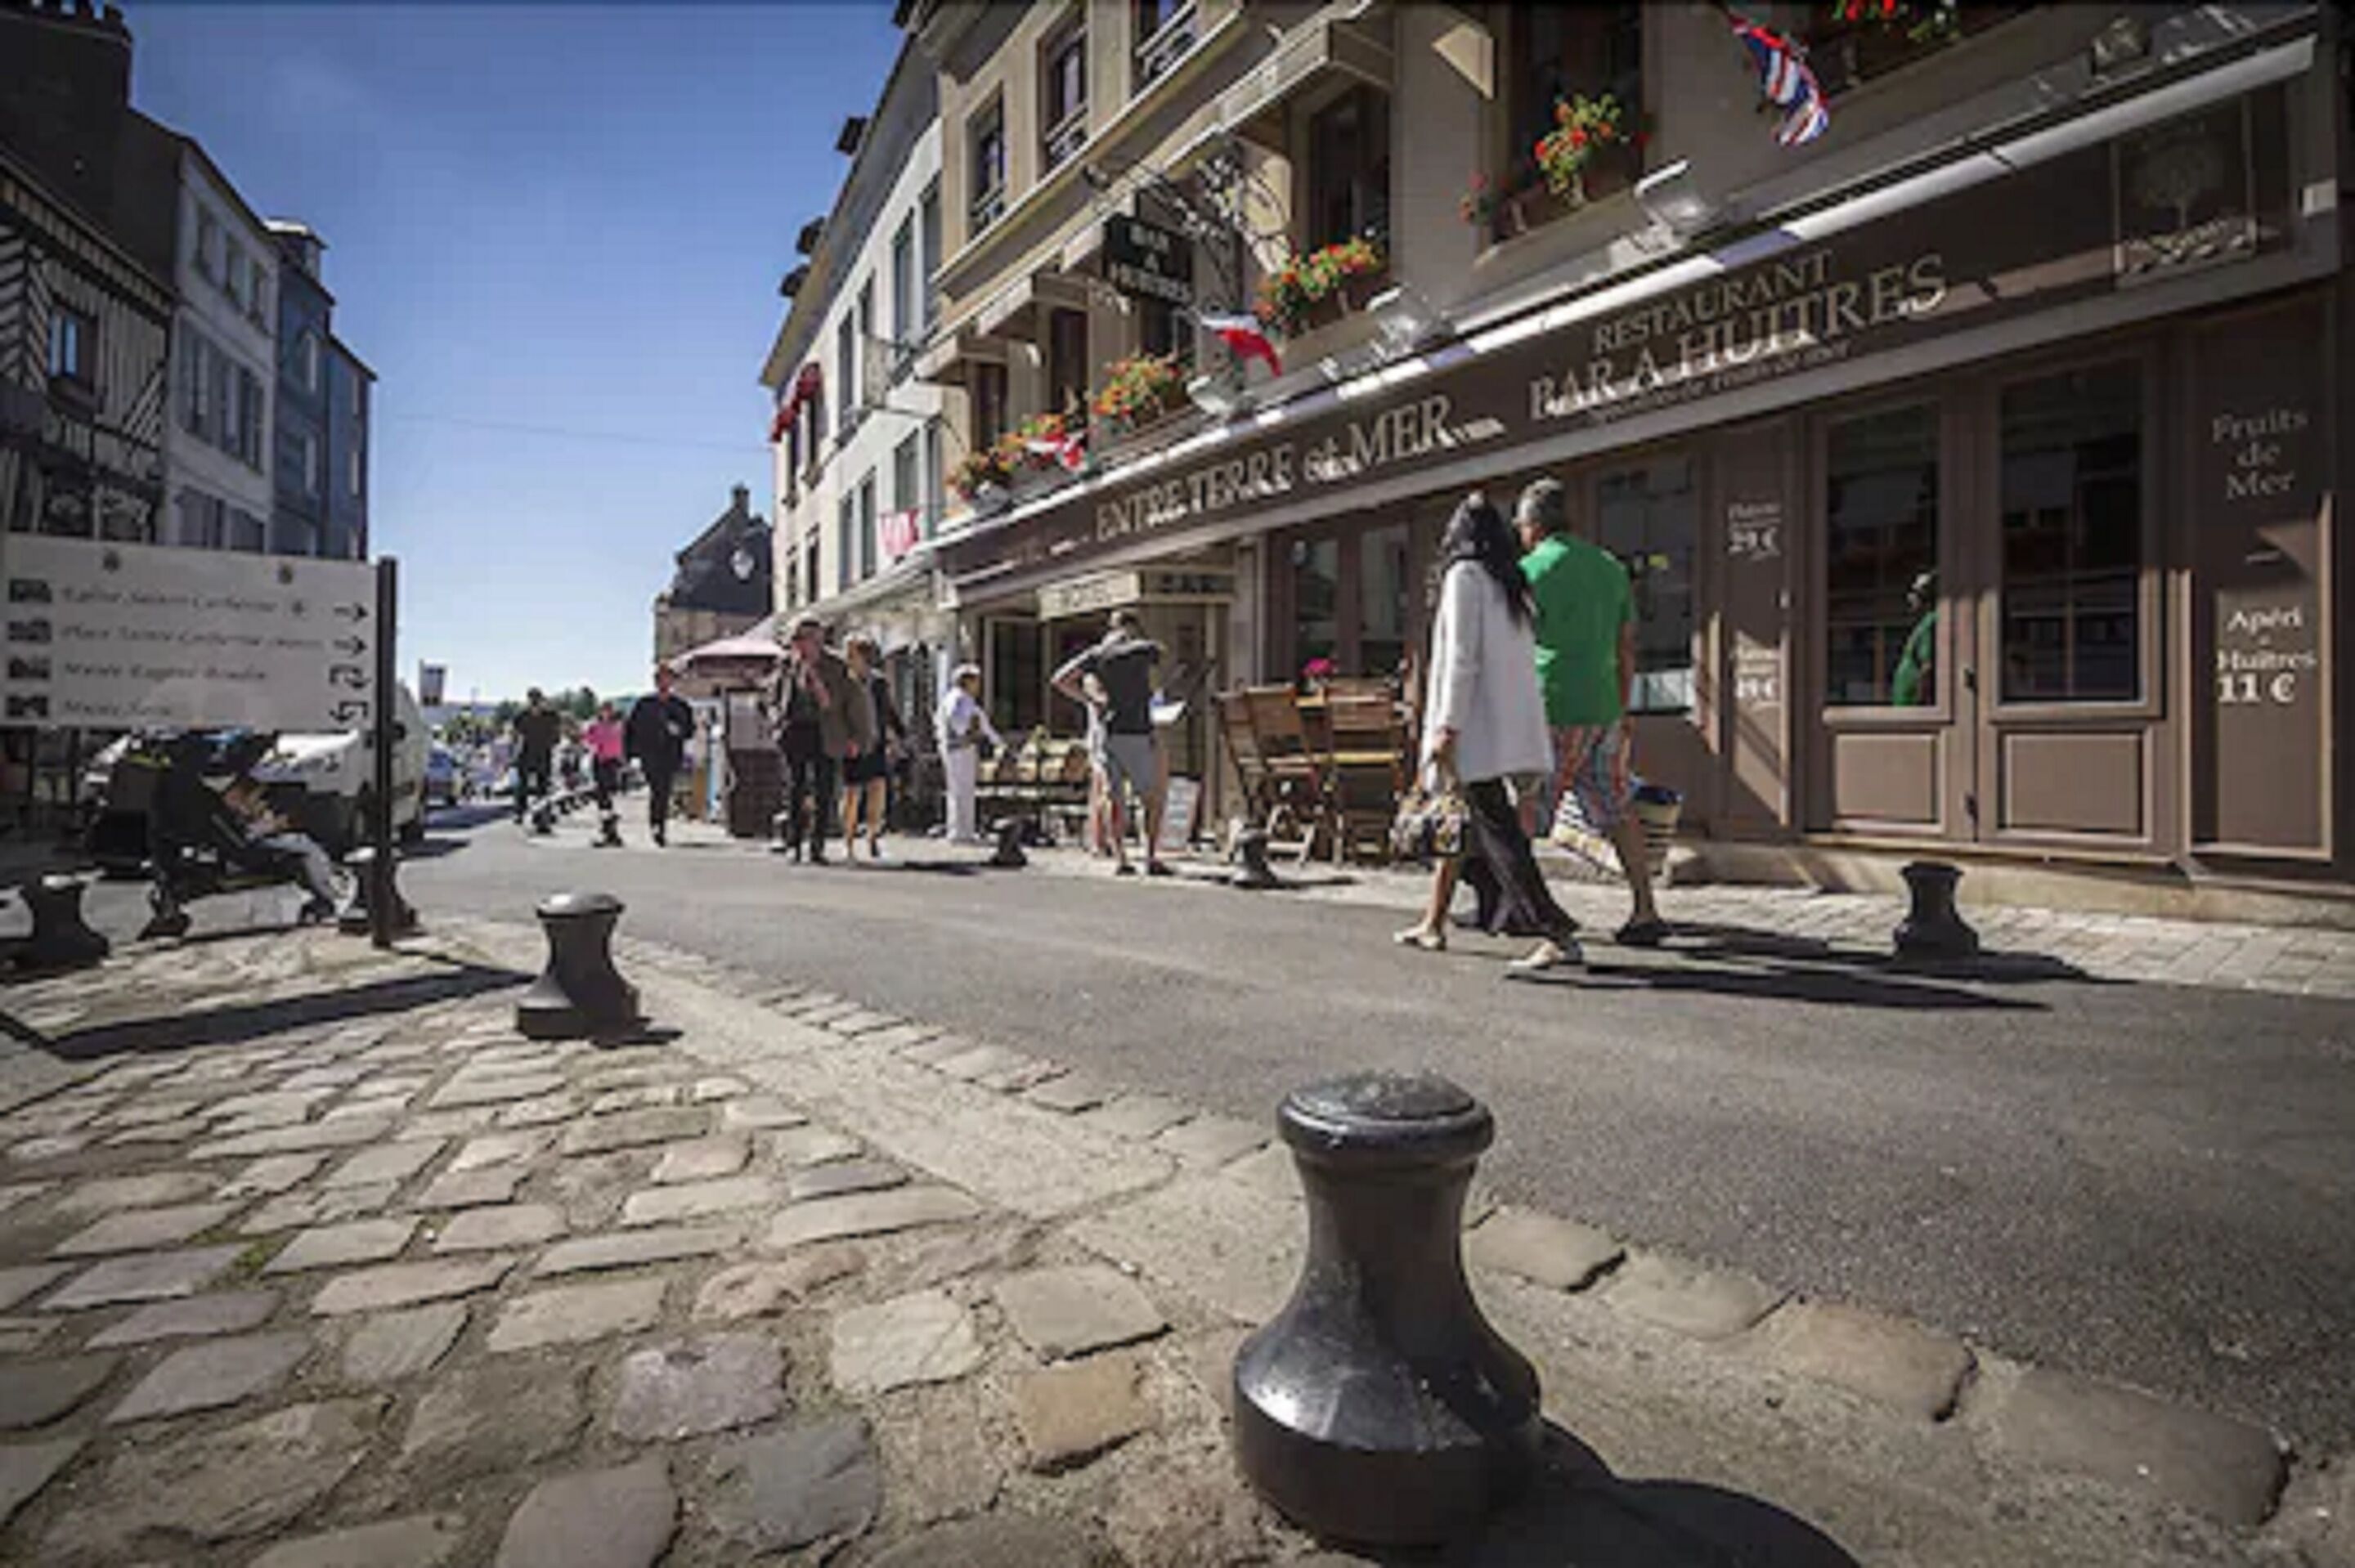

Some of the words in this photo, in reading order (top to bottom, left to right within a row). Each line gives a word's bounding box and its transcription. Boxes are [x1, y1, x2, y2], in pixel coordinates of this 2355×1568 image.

[1595, 249, 1832, 354] RESTAURANT
[1528, 356, 1617, 420] BAR
[1677, 253, 1946, 377] HUITRES
[2212, 407, 2309, 442] Fruits
[1097, 477, 1187, 542] ENTRE
[1186, 442, 1294, 515] TERRE
[1348, 395, 1456, 471] MER
[2236, 441, 2281, 467] de
[2226, 471, 2295, 500] Mer
[2217, 673, 2262, 704] 11
[2269, 672, 2296, 704] €
